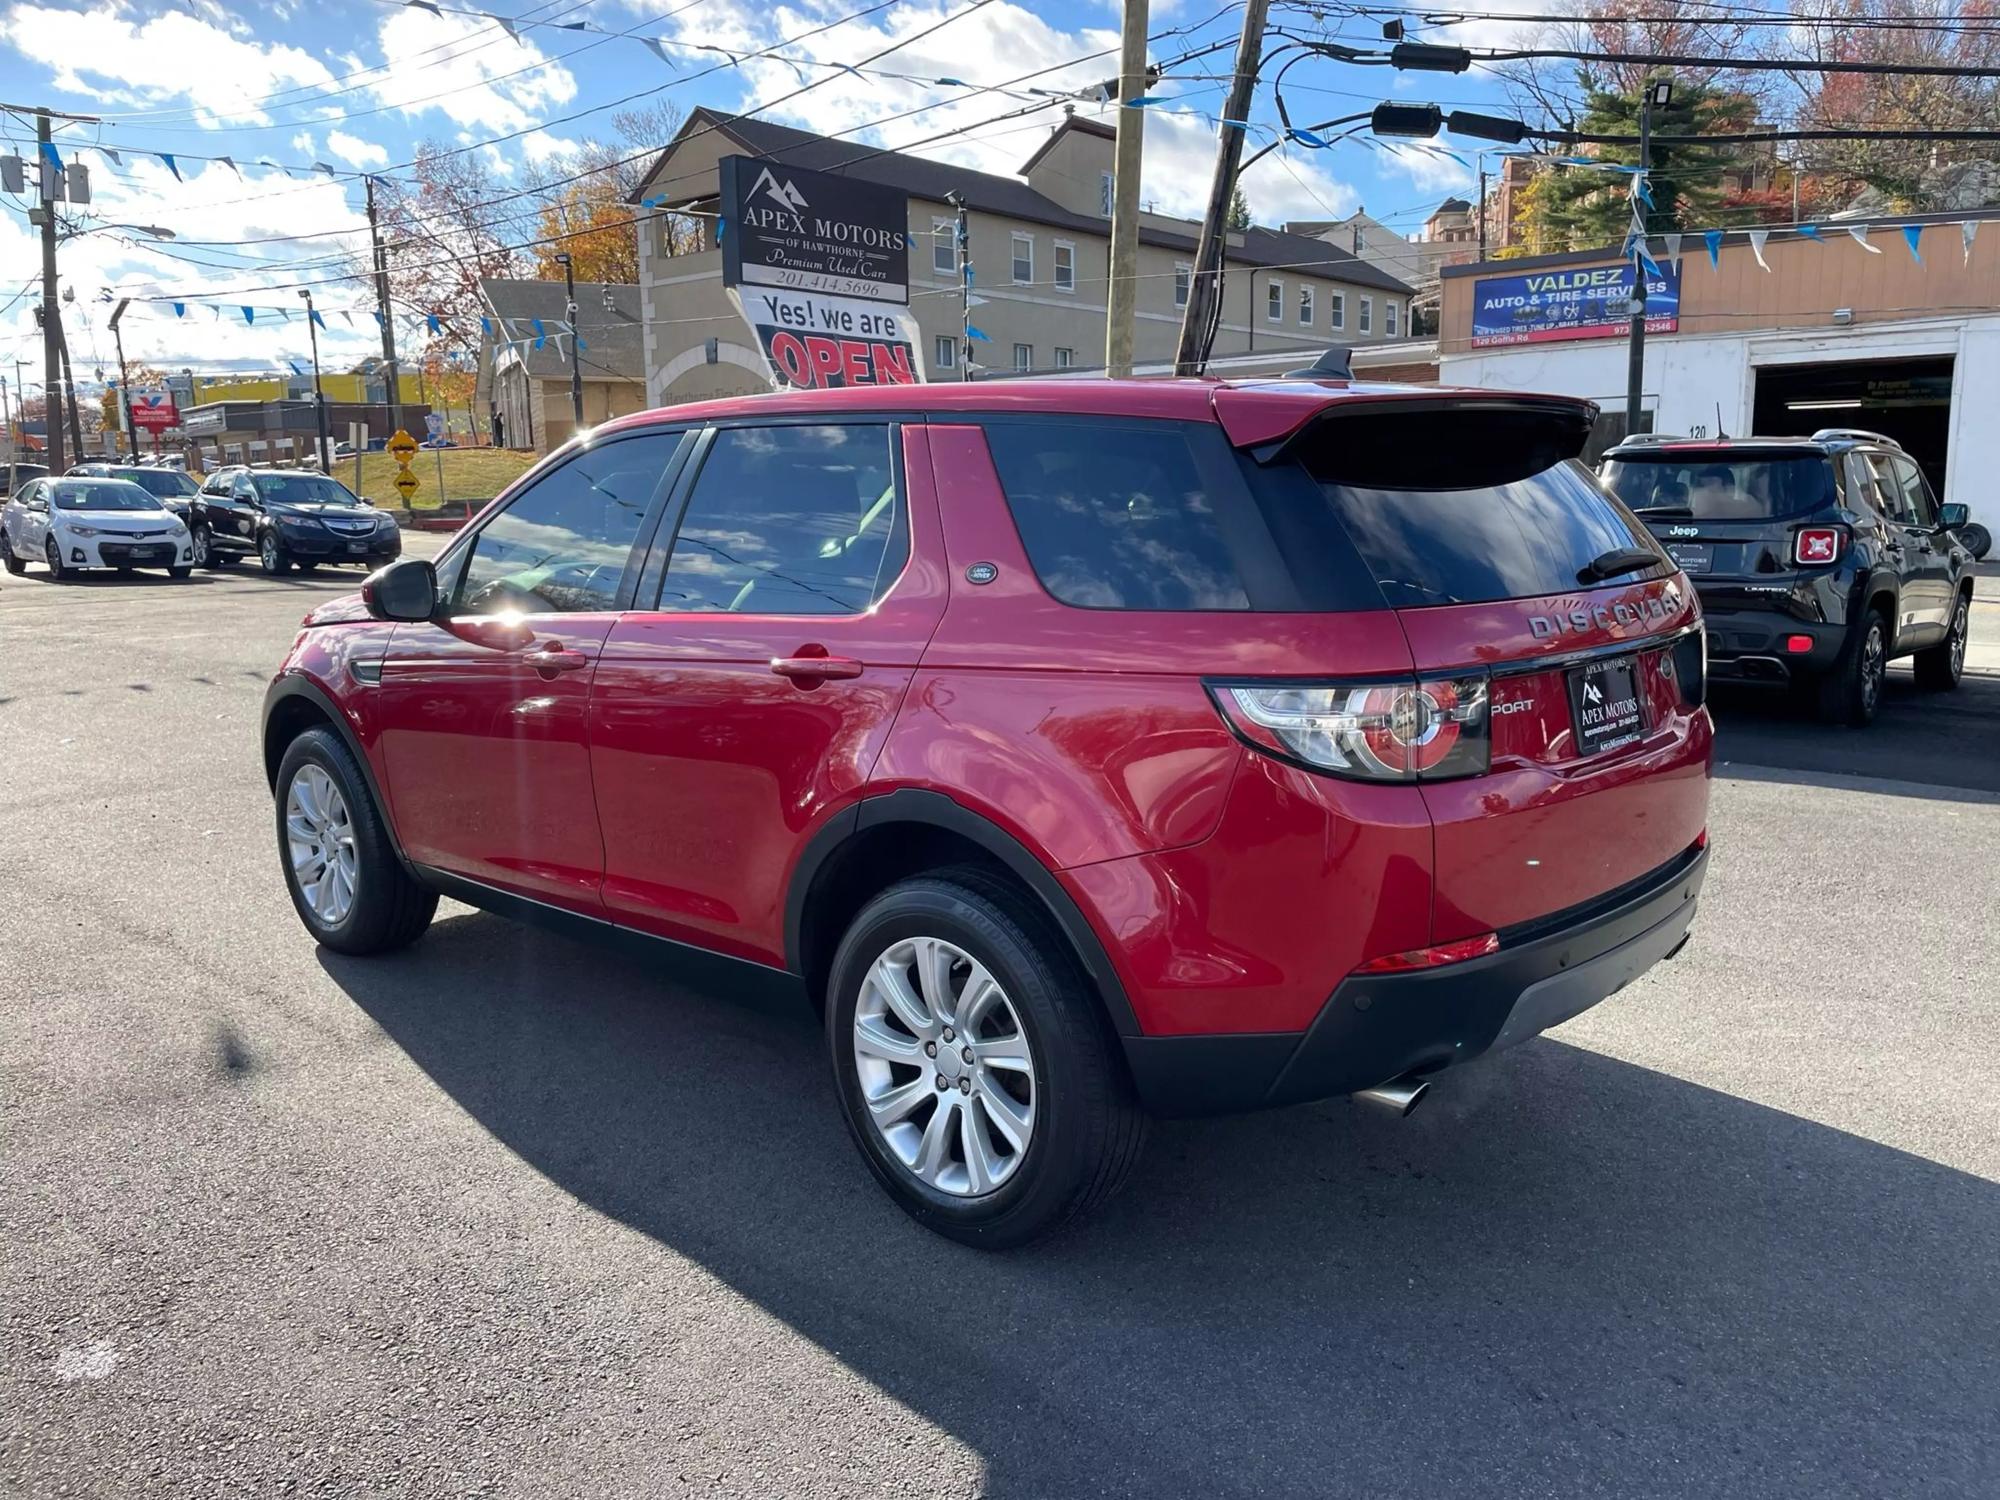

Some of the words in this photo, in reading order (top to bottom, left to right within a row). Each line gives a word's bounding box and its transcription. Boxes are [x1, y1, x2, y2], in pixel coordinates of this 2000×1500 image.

[744, 207, 807, 234] APEX
[815, 219, 904, 251] MOTORS
[786, 237, 800, 248] OF
[803, 240, 865, 258] HAWTHORNE
[766, 248, 823, 270] Premium
[827, 257, 861, 275] Used
[860, 262, 887, 280] Cars
[776, 271, 879, 297] 201.414.5696
[1525, 268, 1624, 293] VALDEZ
[1484, 296, 1525, 310] AUTO
[1529, 294, 1541, 305] &
[1545, 290, 1581, 303] TIRE
[1586, 282, 1667, 299] SERVIES
[762, 295, 815, 328] Yes!
[821, 309, 853, 332] we
[860, 314, 896, 337] are
[1517, 334, 1529, 342] Rd
[771, 332, 915, 389] OPEN
[1690, 425, 1706, 439] 120
[1669, 525, 1699, 538] Jeep
[1585, 663, 1601, 675] APEX
[1602, 658, 1626, 671] MOTORS
[1582, 707, 1604, 726] APEX
[1605, 697, 1638, 719] MOTORS
